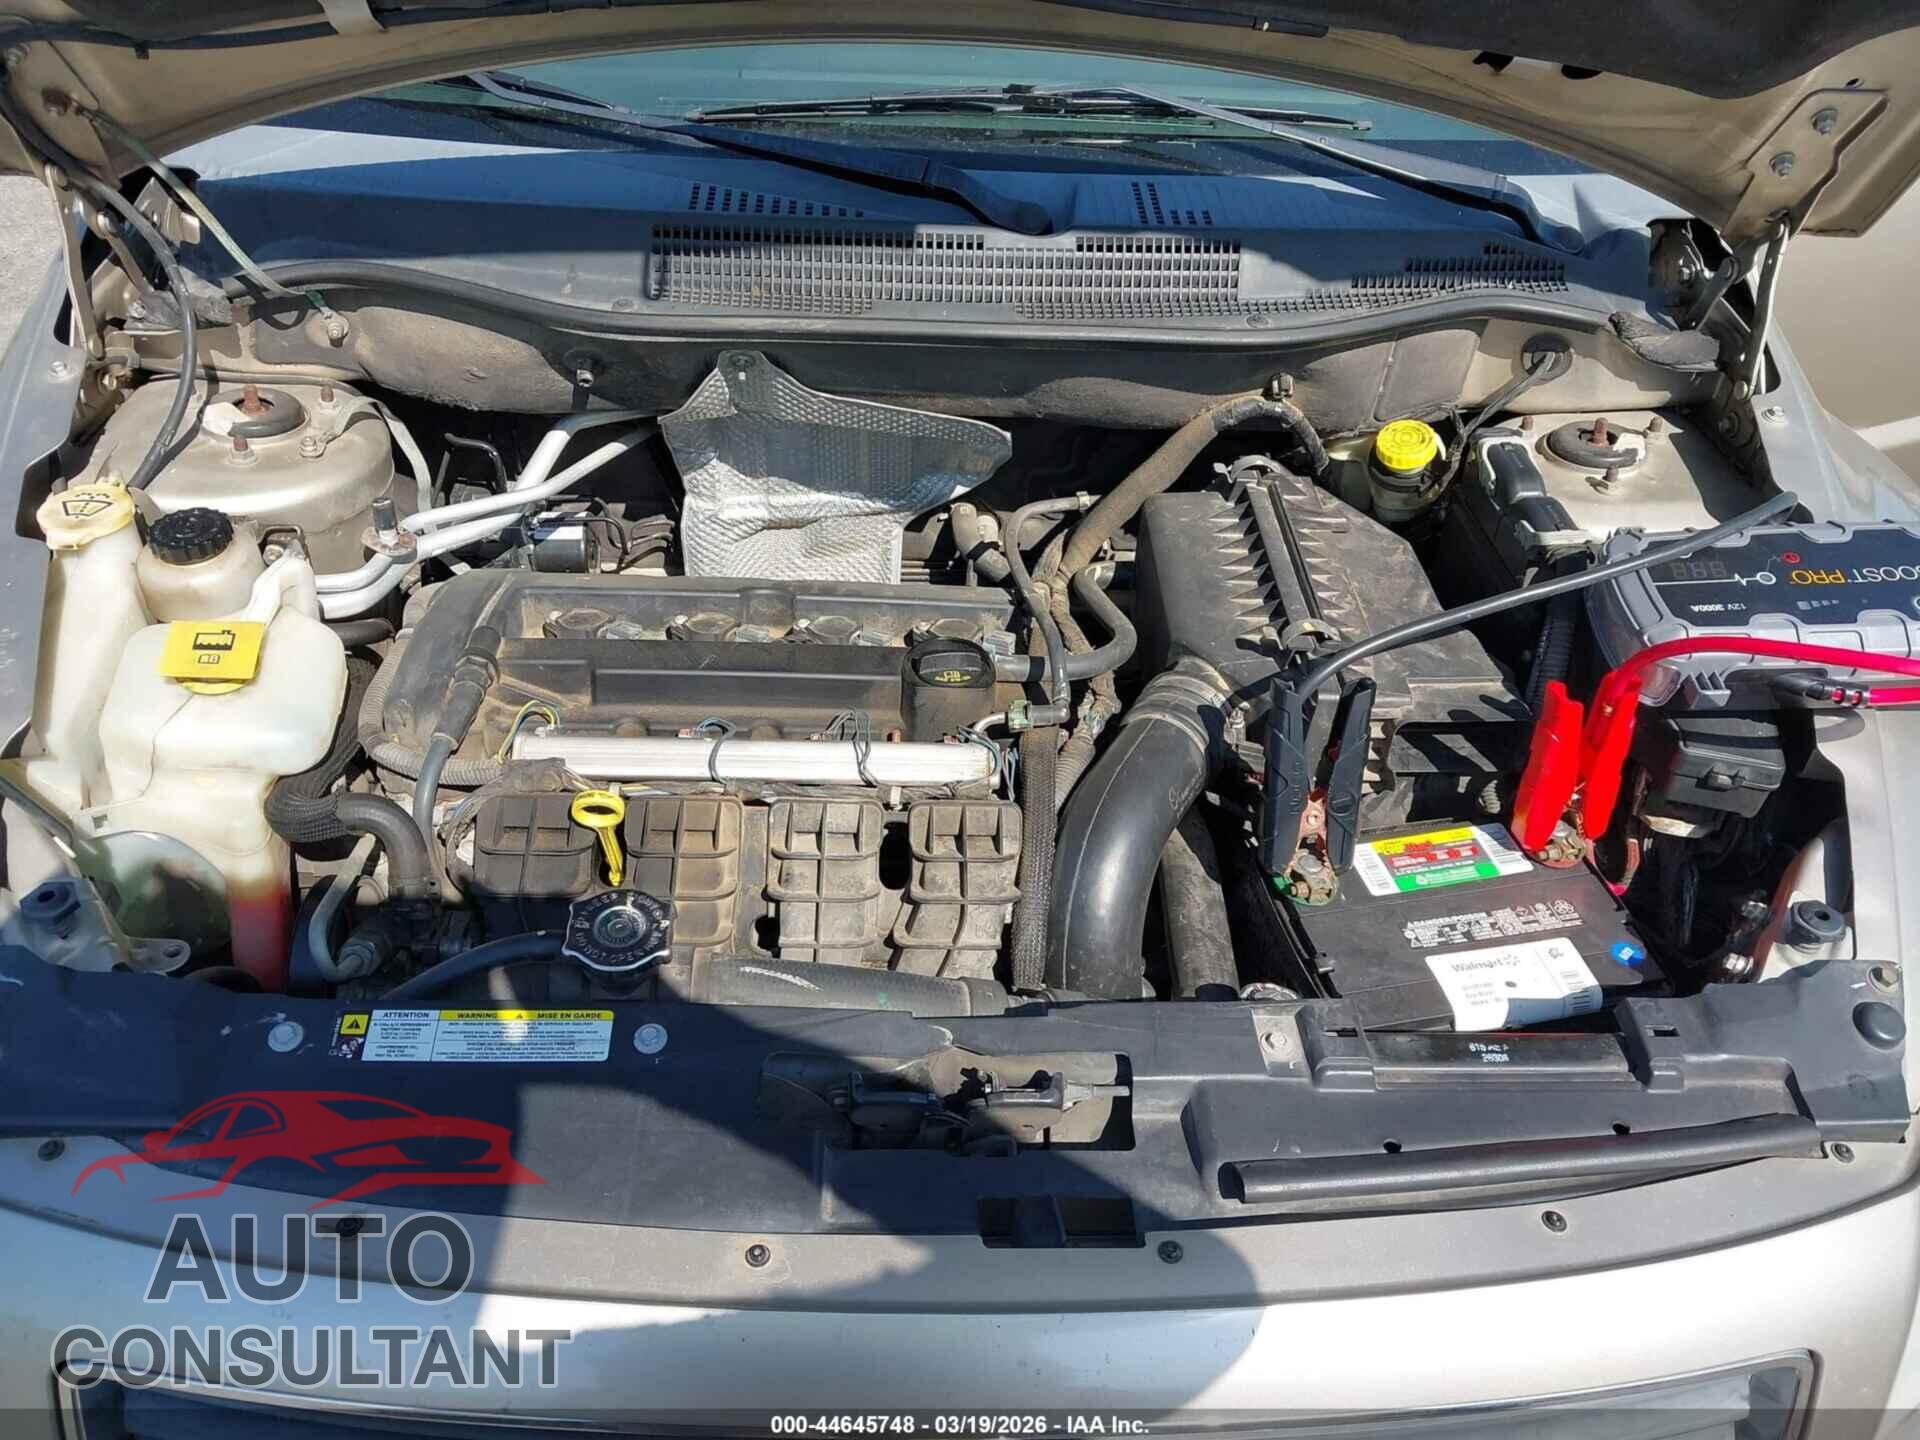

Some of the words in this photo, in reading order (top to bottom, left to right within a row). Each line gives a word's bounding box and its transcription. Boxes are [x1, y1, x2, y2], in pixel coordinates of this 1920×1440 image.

[1790, 568, 1846, 585] PRO
[1690, 603, 1725, 613] 3000A
[1726, 602, 1747, 612] 12V
[1452, 960, 1503, 973] Walmart
